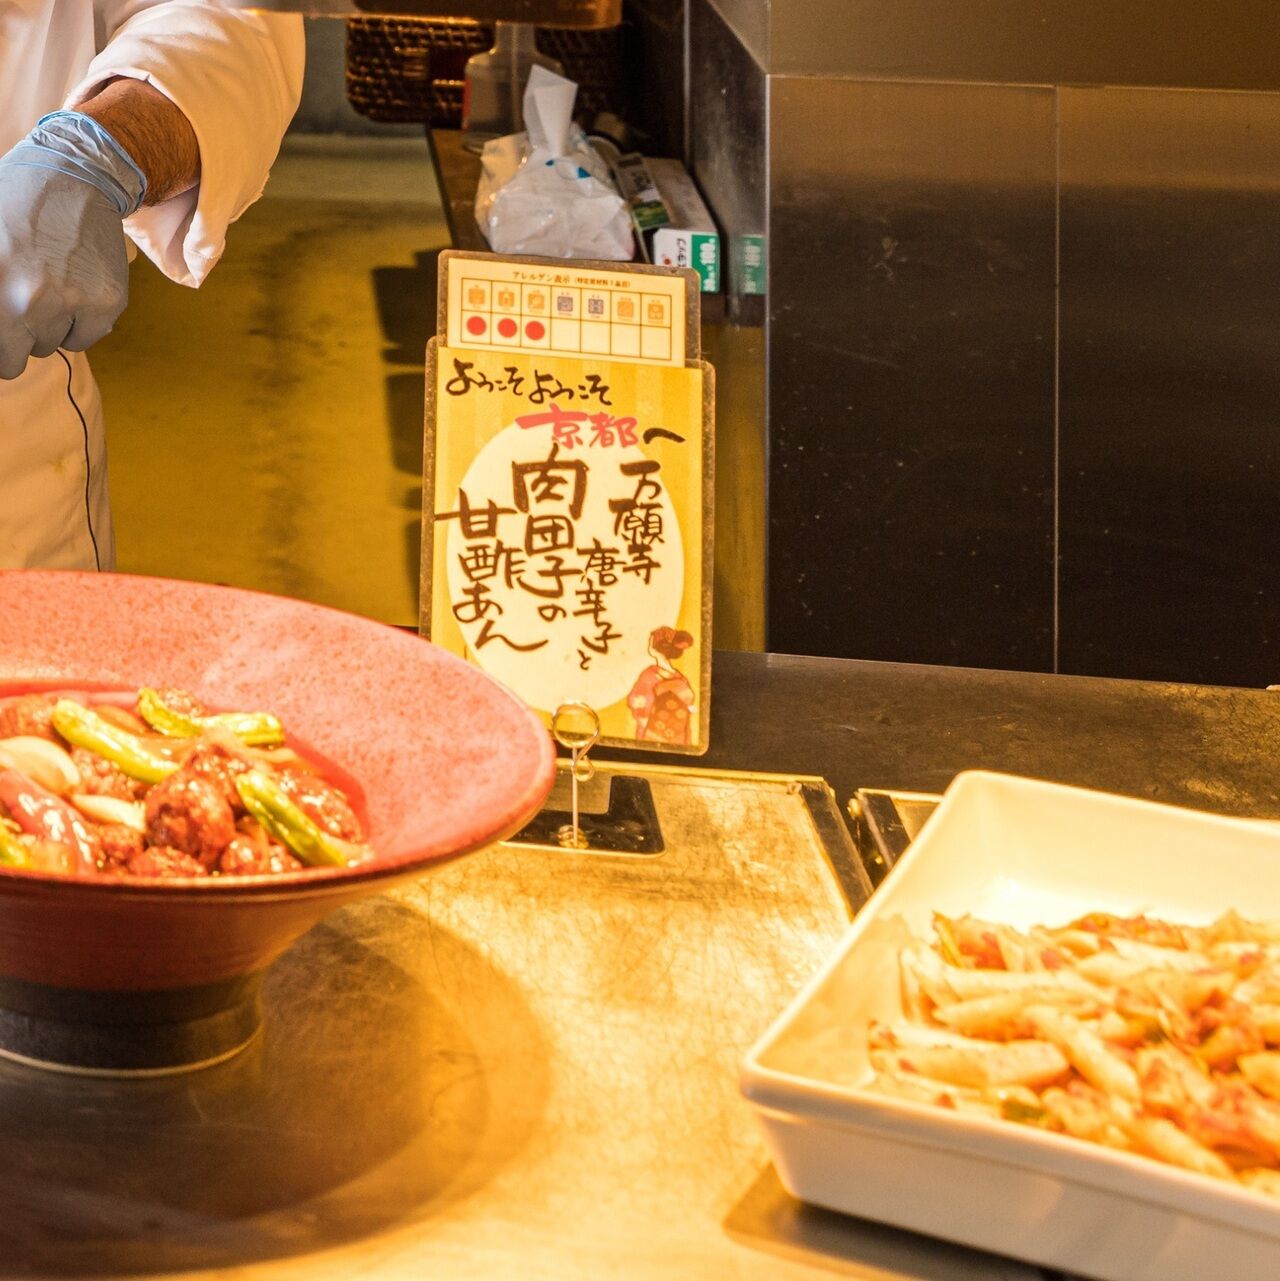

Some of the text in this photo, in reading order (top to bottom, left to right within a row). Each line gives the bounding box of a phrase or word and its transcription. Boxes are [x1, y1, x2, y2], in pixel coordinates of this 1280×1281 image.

[433, 487, 549, 651] 甘酢あん
[512, 442, 590, 621] 肉団子の
